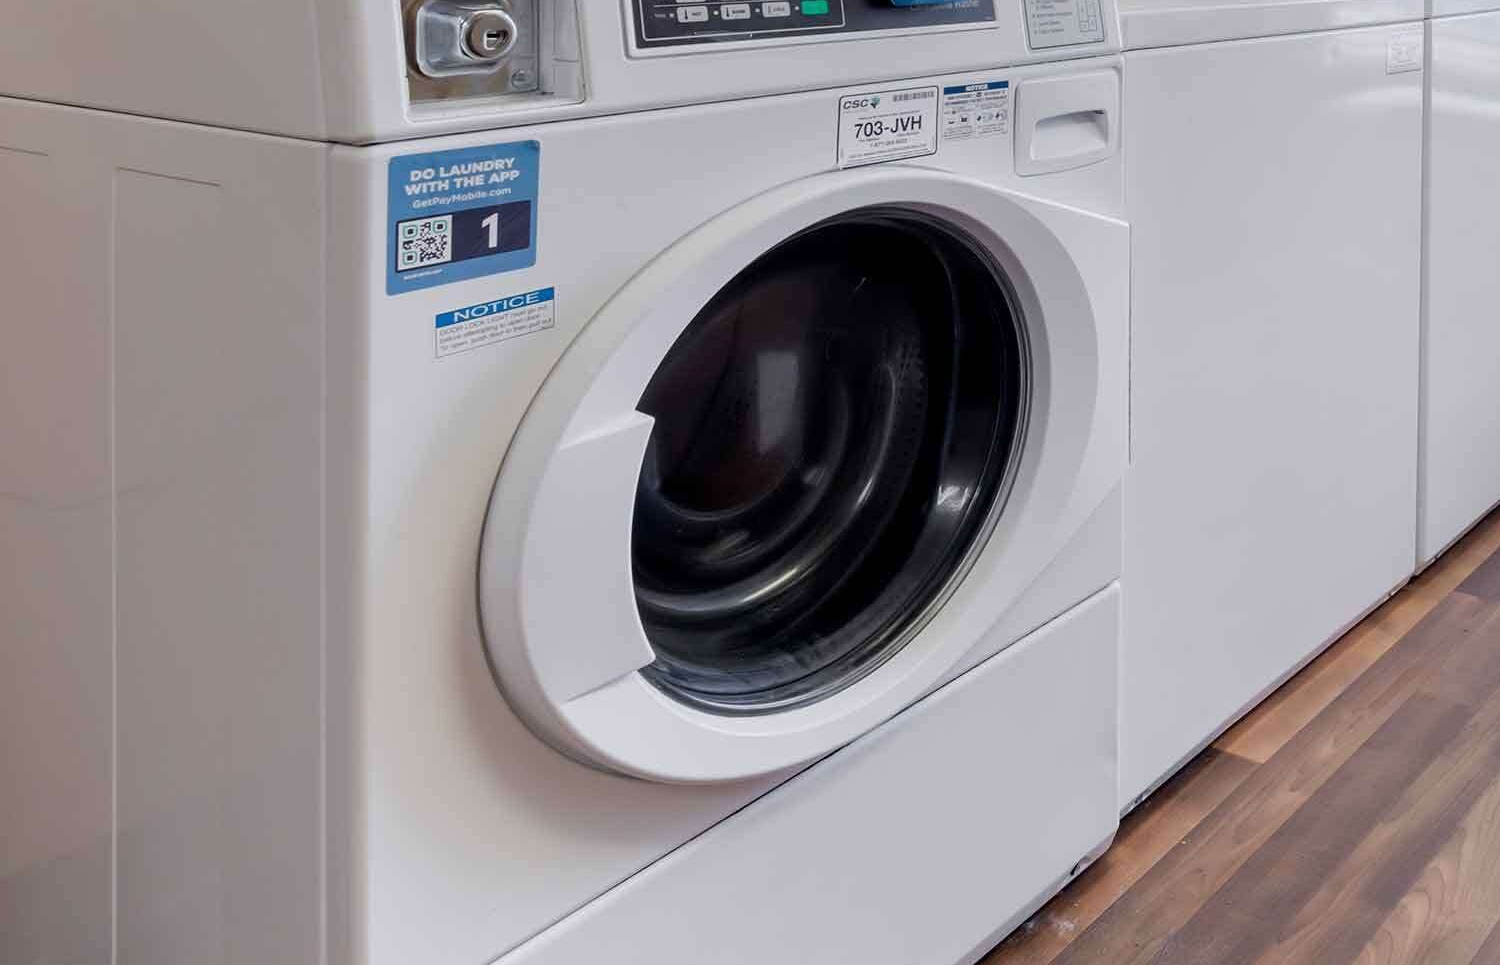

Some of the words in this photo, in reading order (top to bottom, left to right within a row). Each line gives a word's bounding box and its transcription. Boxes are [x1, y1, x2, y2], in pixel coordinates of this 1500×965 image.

[843, 98, 869, 110] CSC
[854, 115, 922, 139] 703-JVH
[404, 179, 450, 196] WITH
[453, 174, 485, 188] THE
[488, 169, 521, 184] APP
[410, 167, 435, 183] DO
[439, 157, 516, 179] LAUNDRY
[412, 187, 512, 210] GetPayMobile.com
[481, 213, 499, 249] 1
[453, 291, 541, 323] NOTICE
